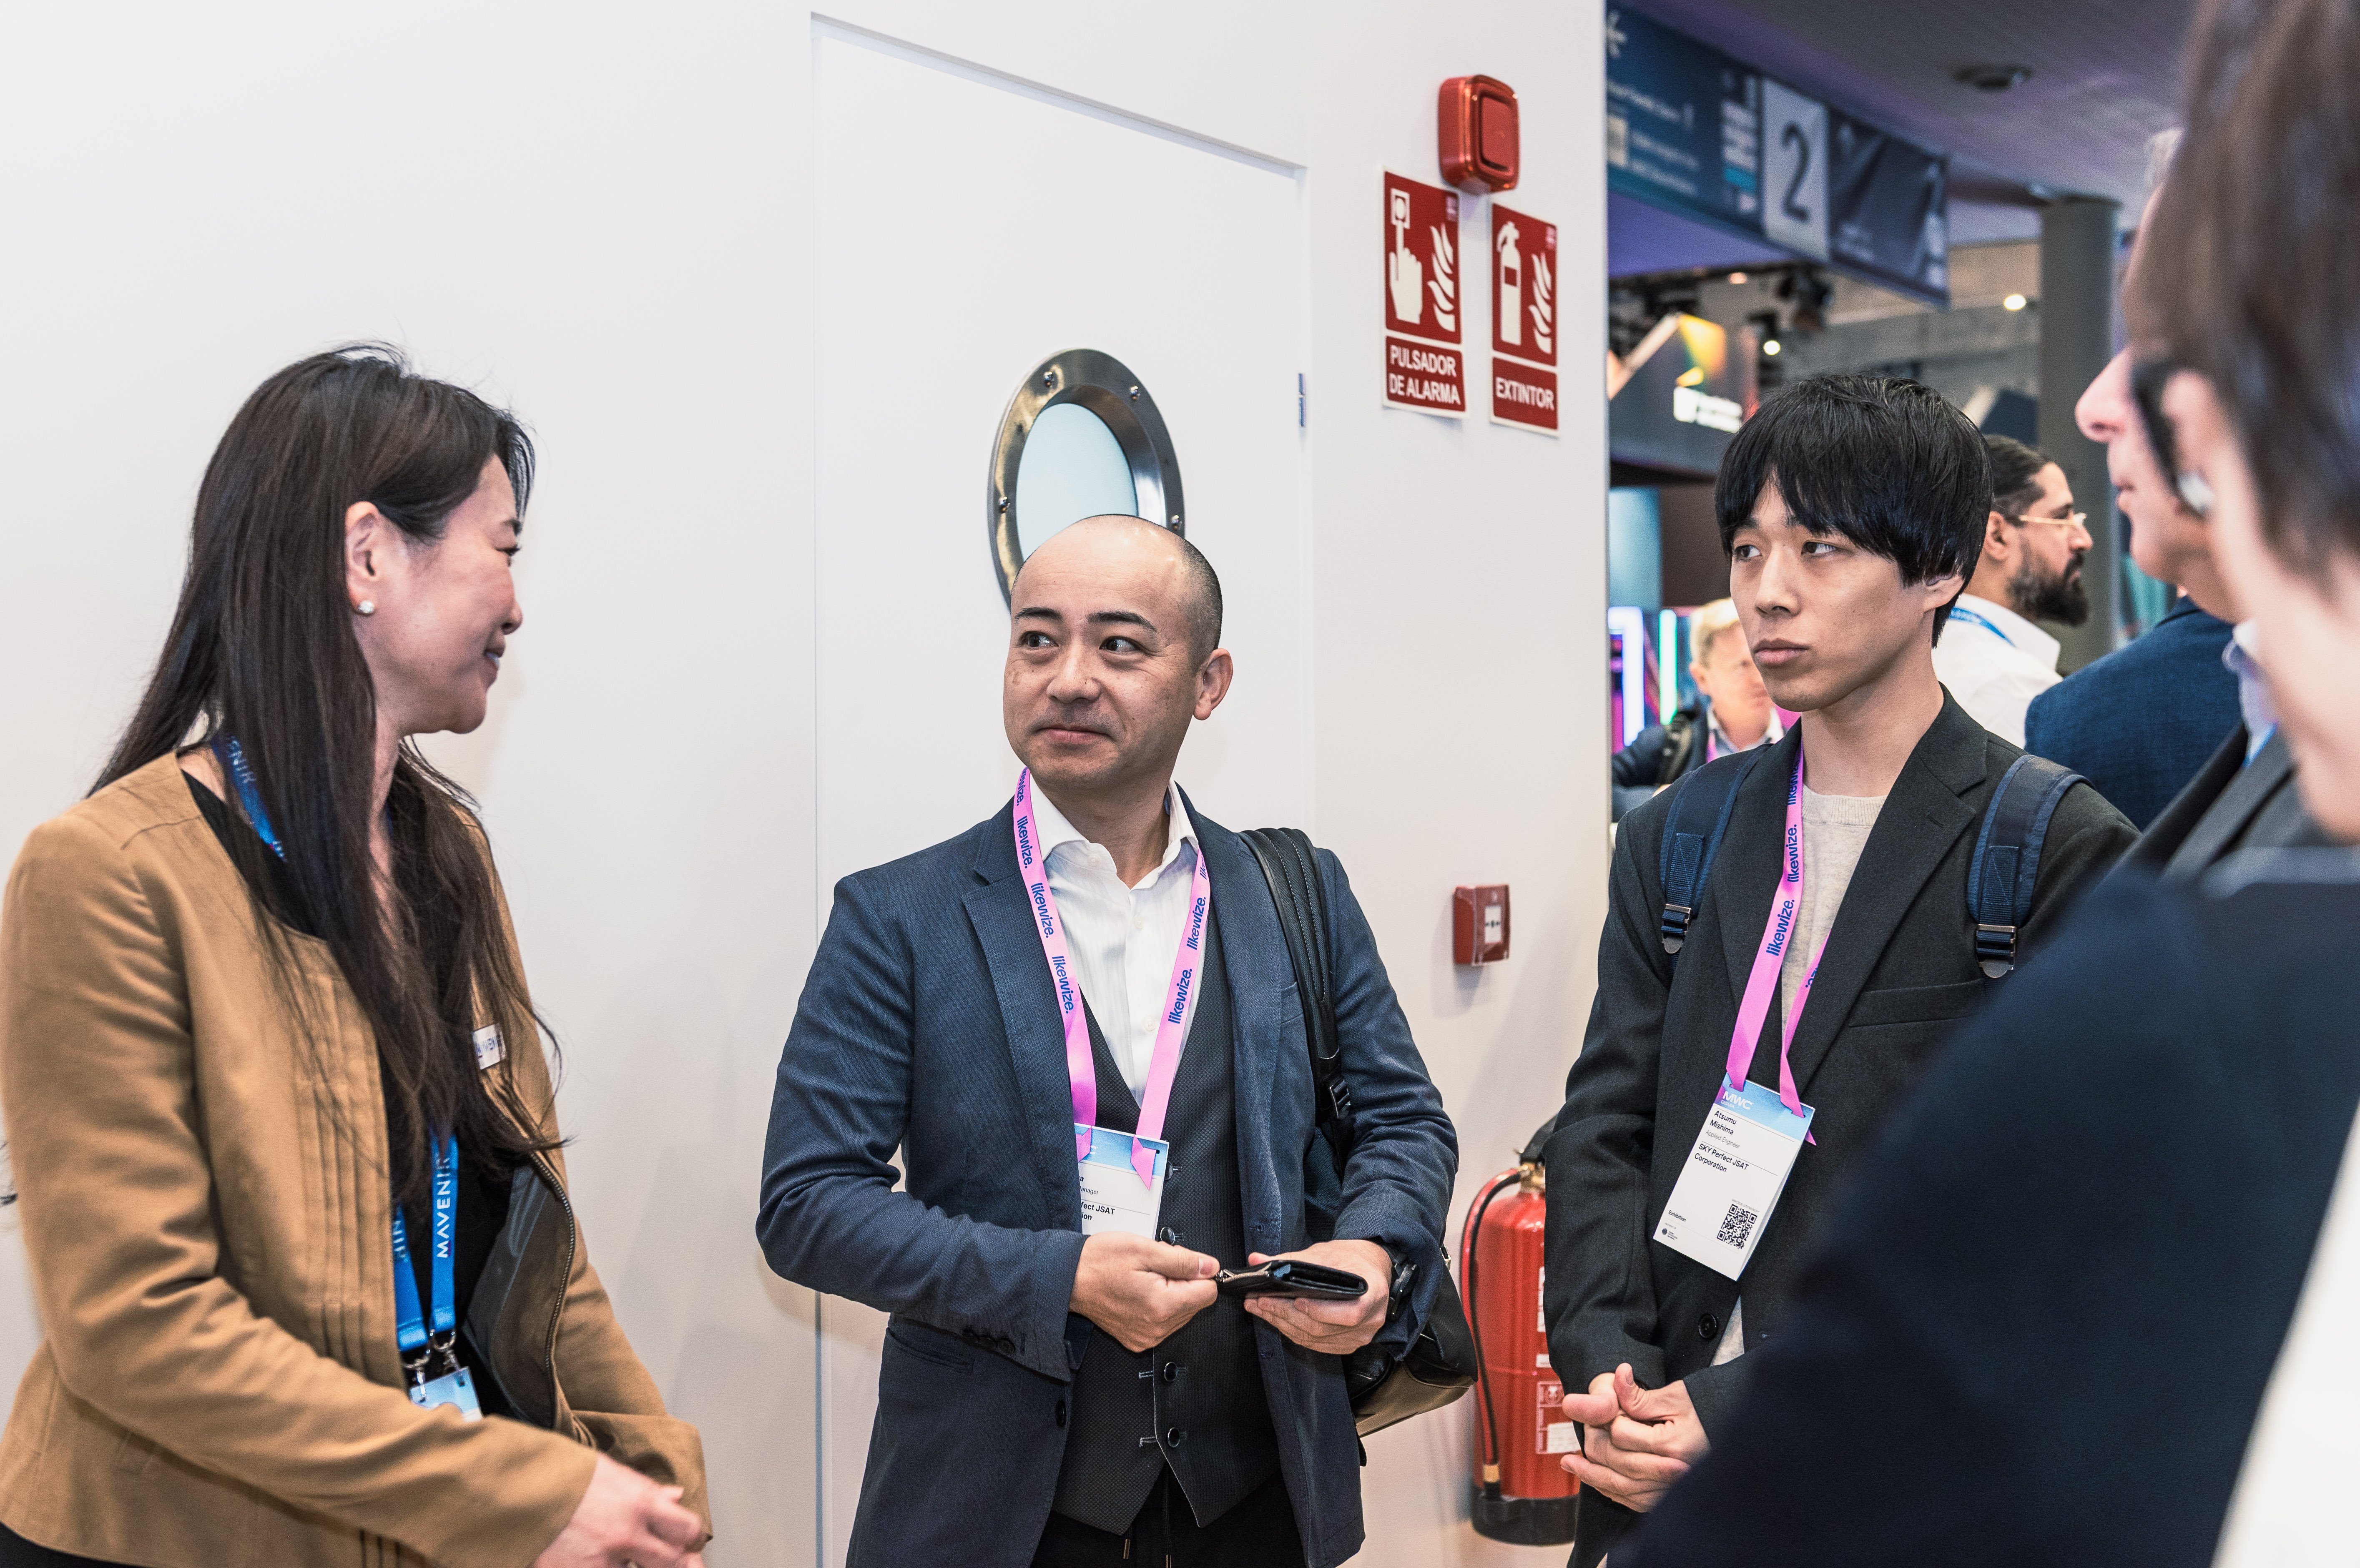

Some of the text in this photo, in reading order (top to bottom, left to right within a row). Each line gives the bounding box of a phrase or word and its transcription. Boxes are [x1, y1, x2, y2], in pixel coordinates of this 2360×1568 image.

[1782, 121, 1810, 222] 2
[1390, 345, 1457, 377] PULSADOR
[1388, 373, 1461, 405] DE ALARMA
[1495, 376, 1554, 410] EXTINTOR
[1017, 815, 1033, 869] likewize.
[1785, 824, 1799, 882] likewize.
[1031, 883, 1054, 938] likewize.
[1186, 897, 1206, 950] likewize.
[1766, 900, 1795, 956] likewize.
[1052, 956, 1074, 1014] likewize.
[1168, 968, 1193, 1024] likewize.
[1722, 1091, 1753, 1110] MWC
[1710, 1119, 1734, 1135] Mishima
[1714, 1110, 1737, 1125] Atsumu
[1695, 1153, 1727, 1172] Corporation
[1699, 1144, 1749, 1170] SKY Perfect JSAT
[1080, 1186, 1099, 1195] anager
[1081, 1201, 1115, 1215] fect JSAT
[1668, 1210, 1686, 1222] Exhibition
